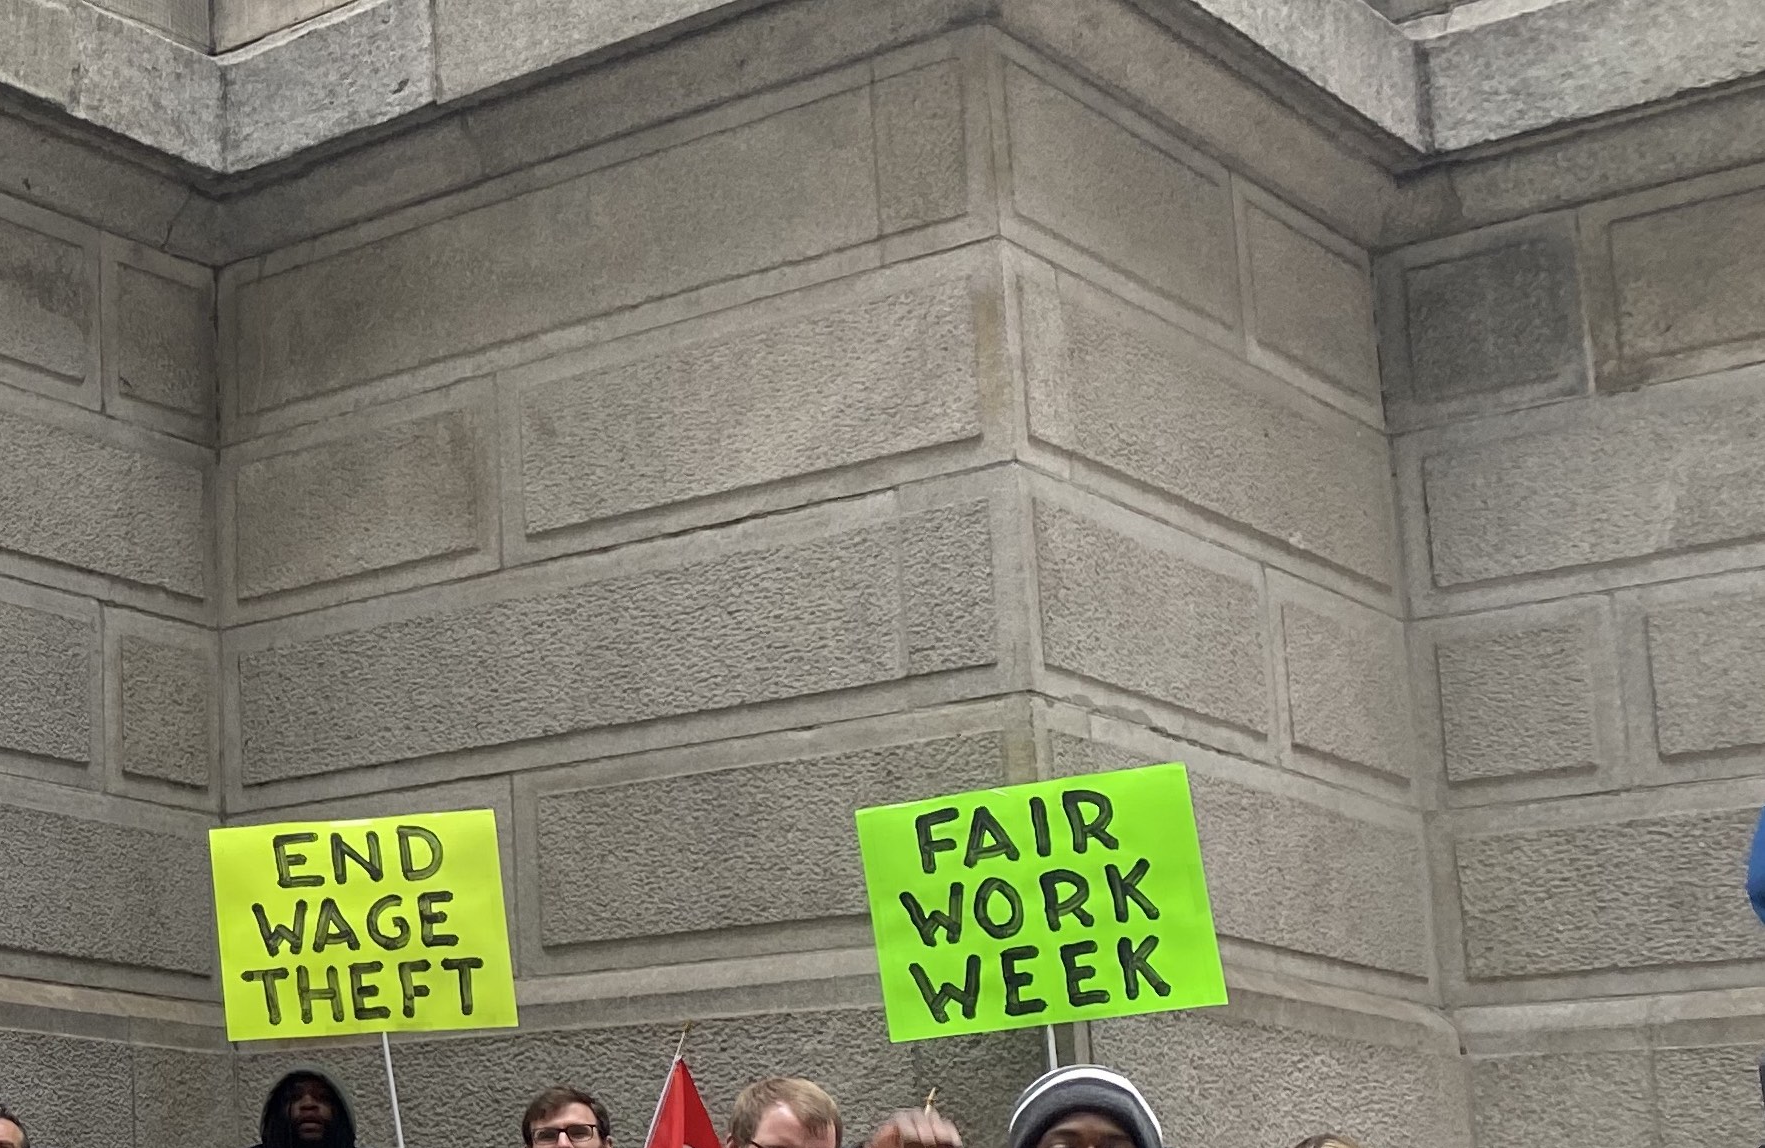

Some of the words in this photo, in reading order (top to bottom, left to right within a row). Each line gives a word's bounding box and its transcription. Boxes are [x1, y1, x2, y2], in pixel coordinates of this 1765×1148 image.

[272, 825, 443, 888] END
[915, 790, 1119, 874] FAIR
[251, 890, 459, 957] WAGE
[899, 858, 1160, 948] WORK
[241, 957, 484, 1025] THEFT
[909, 935, 1172, 1024] WEEK
